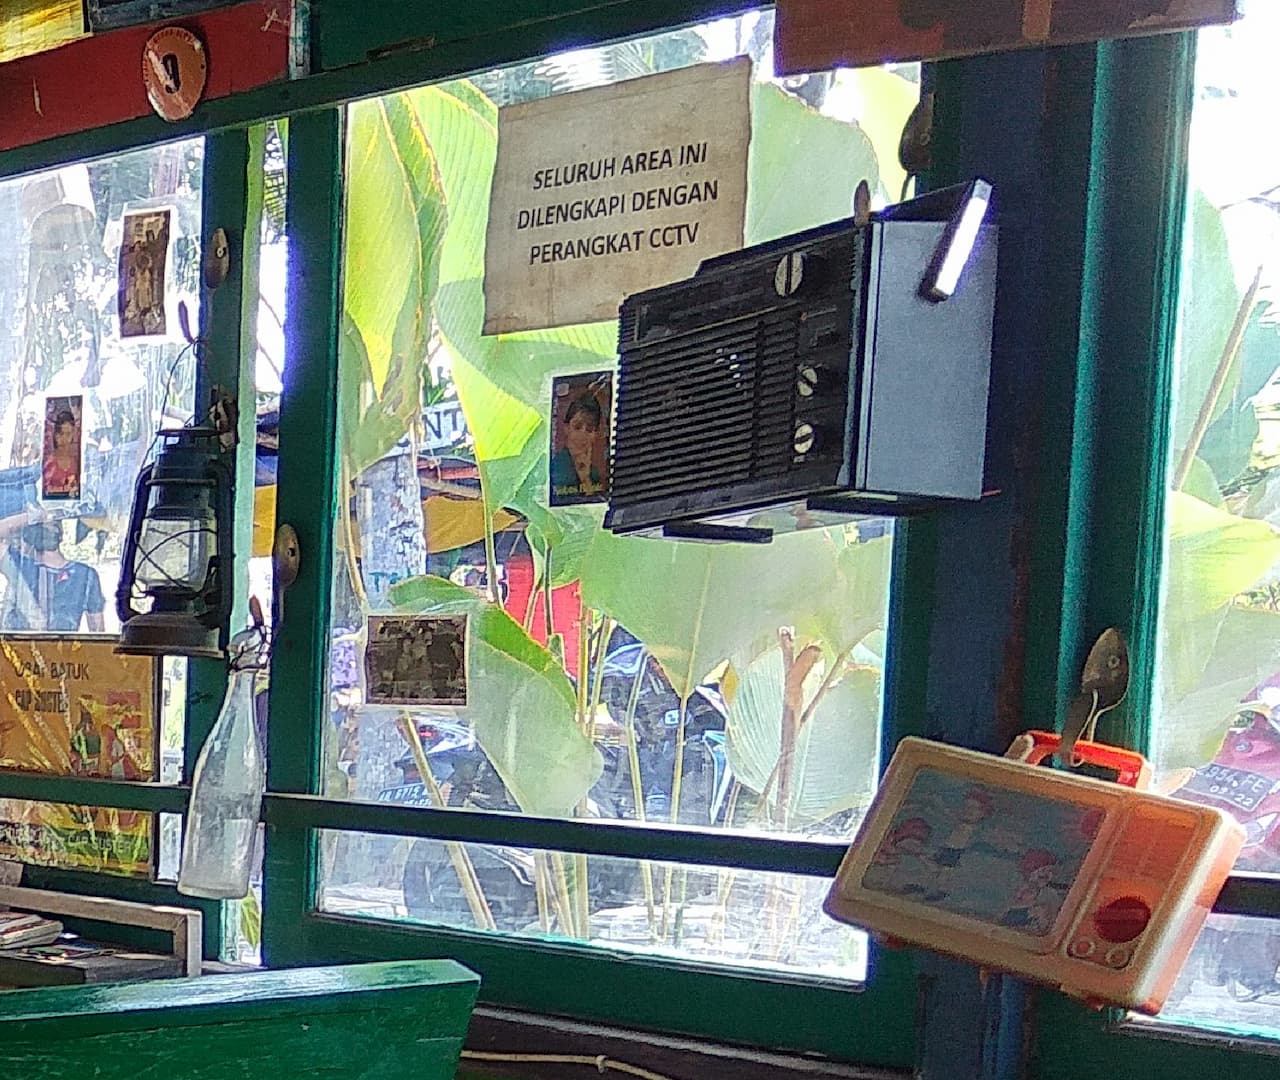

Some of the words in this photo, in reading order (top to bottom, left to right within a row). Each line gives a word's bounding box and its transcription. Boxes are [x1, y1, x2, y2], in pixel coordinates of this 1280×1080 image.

[532, 157, 616, 191] SELURUH
[620, 148, 673, 176] AREA
[679, 142, 708, 166] INI
[517, 193, 626, 230] DILENGKAPI
[631, 180, 719, 213] DENGAN
[529, 230, 645, 265] PERANGKAT
[649, 222, 700, 249] CCTV
